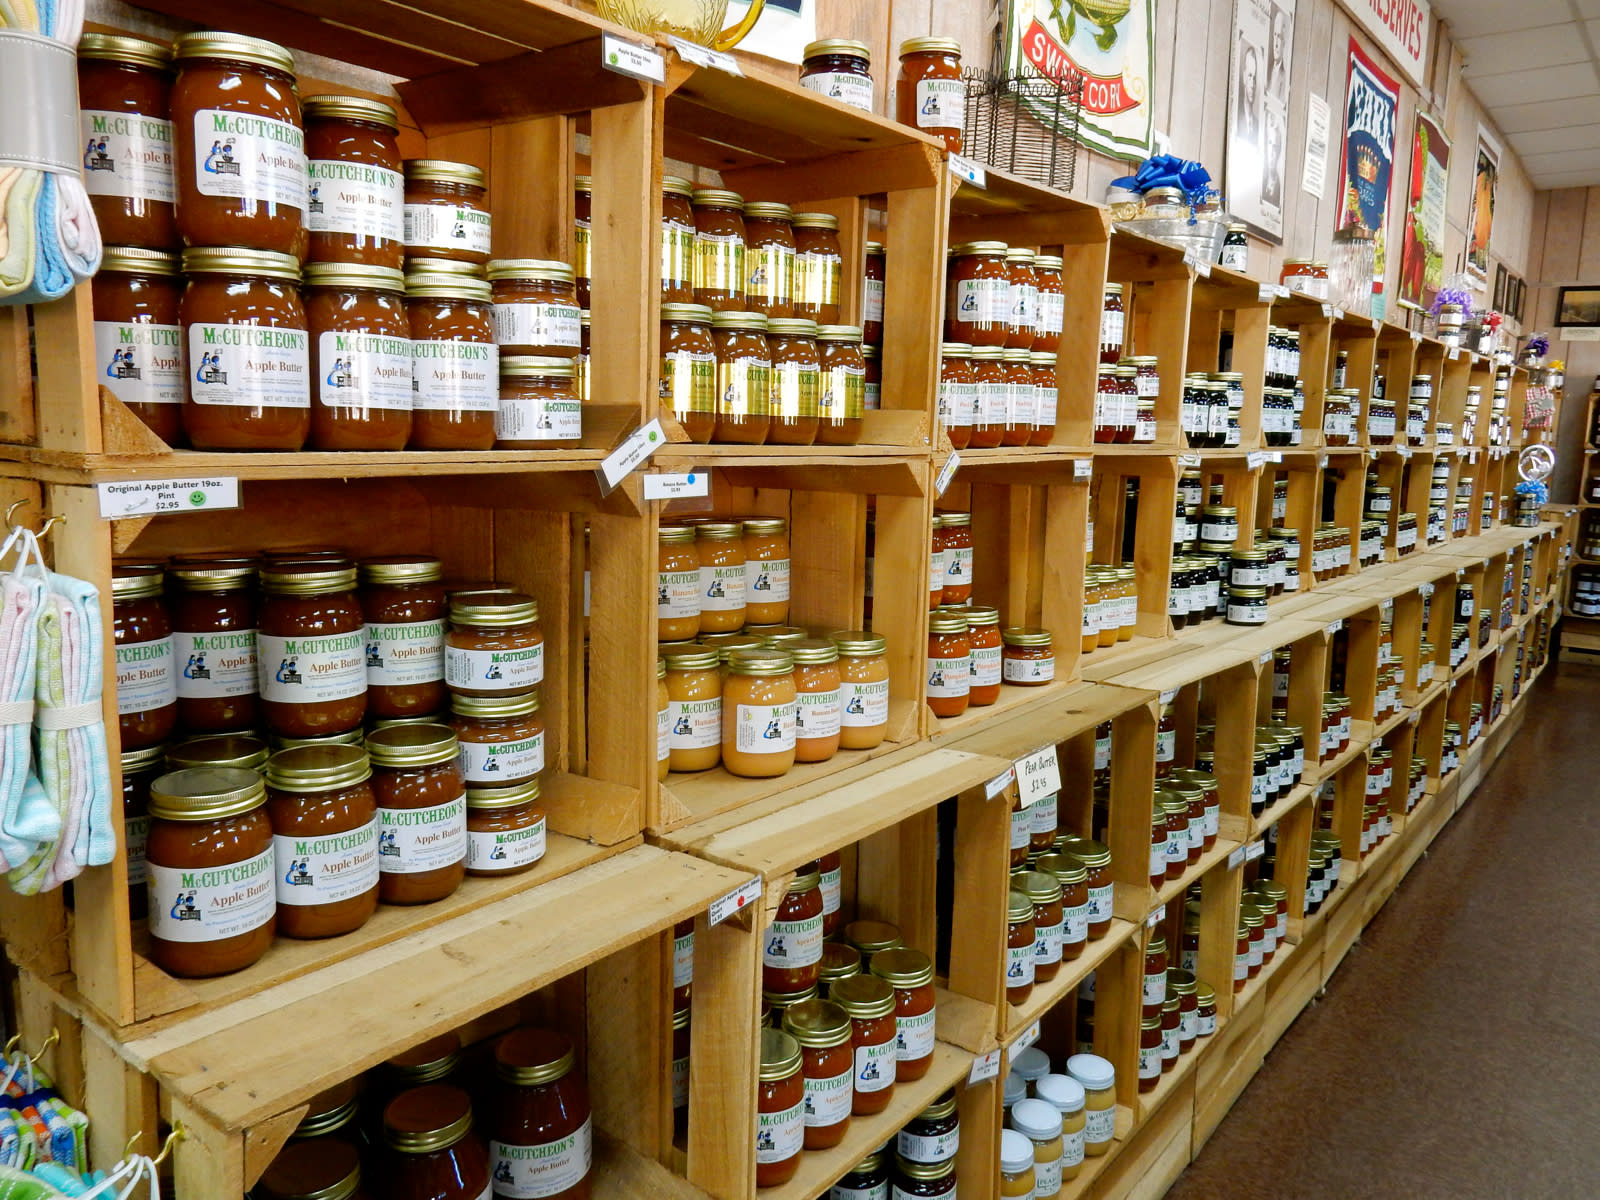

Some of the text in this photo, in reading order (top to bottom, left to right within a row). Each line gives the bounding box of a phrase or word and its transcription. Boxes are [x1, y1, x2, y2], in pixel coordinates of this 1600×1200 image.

[202, 327, 304, 350] McCUTCHEON'S
[245, 359, 303, 373] Apple Butter
[374, 366, 397, 378] Apple
[461, 370, 486, 381] Butter
[107, 480, 223, 494] Original Apple Butter 19oz.
[155, 501, 180, 509] $2.95
[390, 644, 442, 658] Apple Butter
[218, 655, 247, 669] Apple
[309, 657, 362, 673] Apple Butter
[138, 667, 166, 680] Butter
[381, 800, 464, 827] McCUTCHEON'S
[414, 826, 462, 845] Apple Butter
[321, 848, 375, 873] Apple Butter
[210, 879, 271, 907] Apple Butter
[500, 1136, 575, 1160] McCUTCHEON'S
[528, 1163, 549, 1175] Apple
